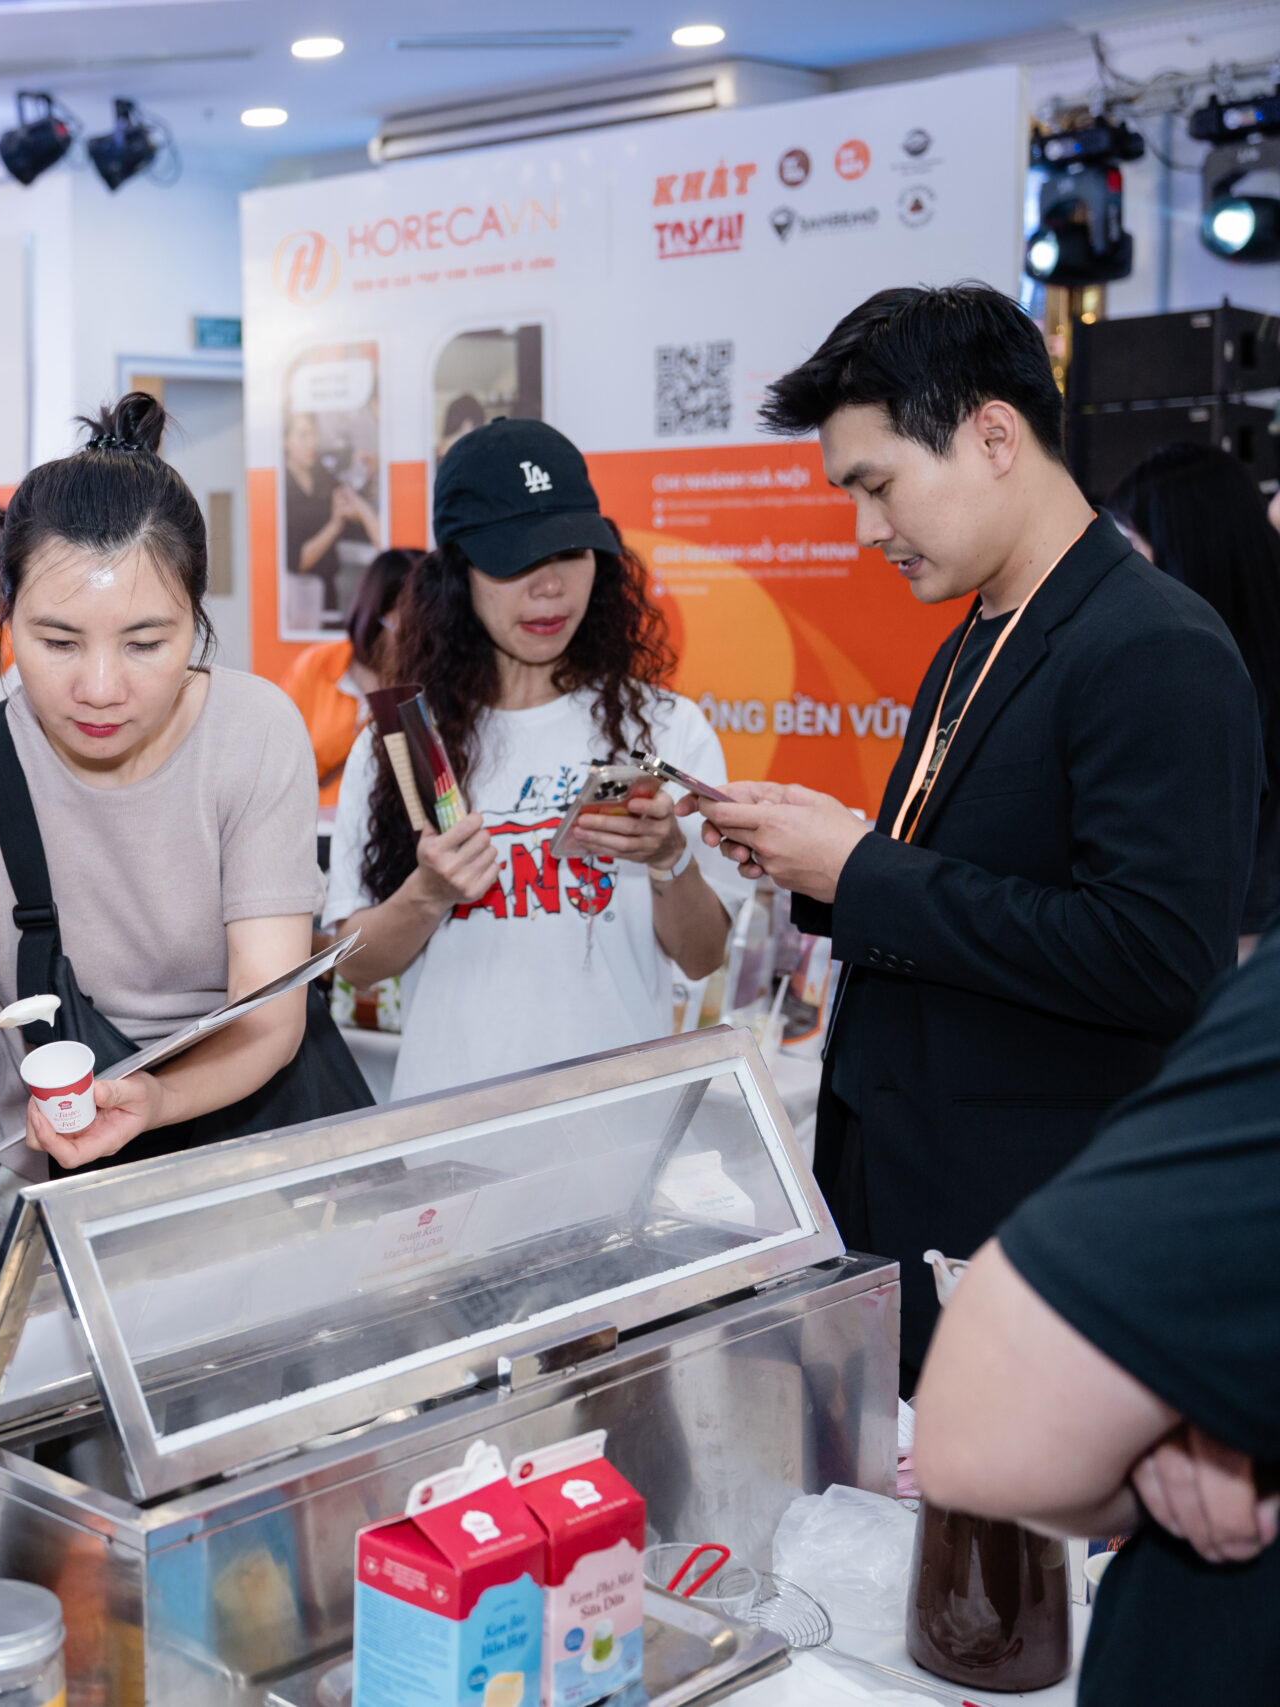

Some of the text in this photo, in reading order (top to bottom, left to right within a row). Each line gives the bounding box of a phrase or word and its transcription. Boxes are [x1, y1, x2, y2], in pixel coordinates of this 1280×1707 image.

[652, 158, 758, 206] KHÁT
[347, 195, 558, 259] HORECAVN
[519, 461, 553, 493] LA
[699, 692, 766, 733] ÔNG
[773, 693, 842, 736] BỀN
